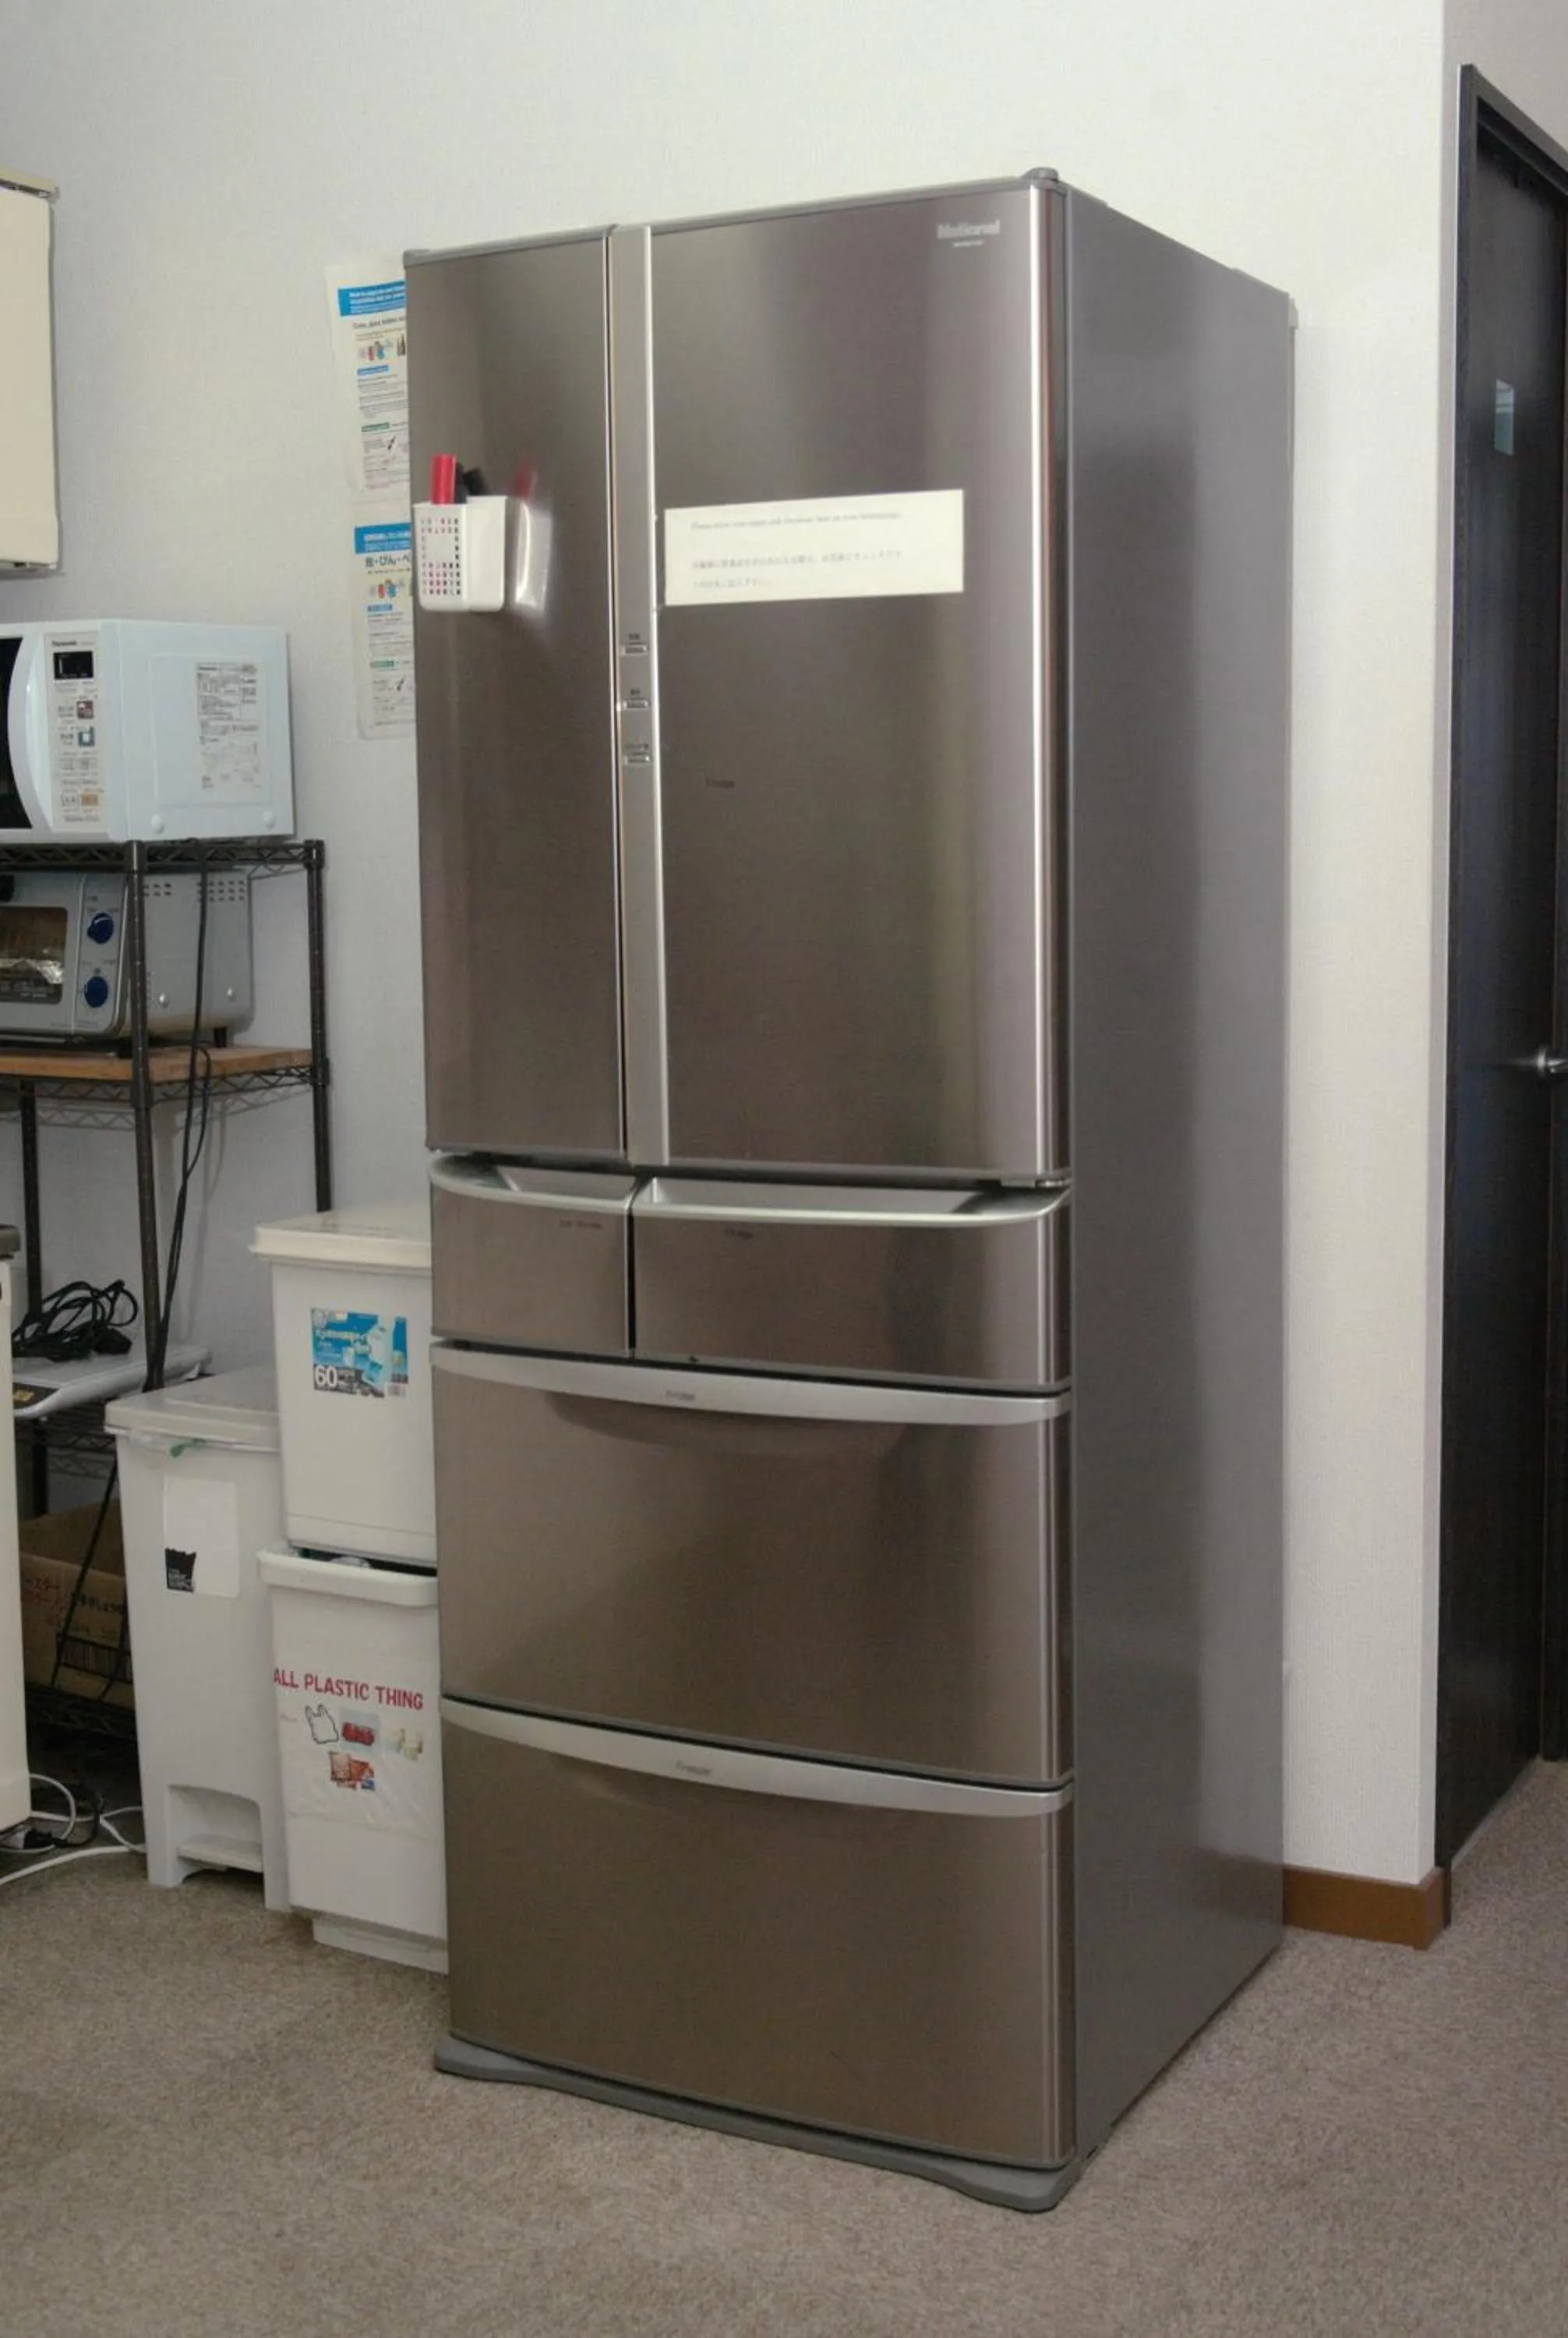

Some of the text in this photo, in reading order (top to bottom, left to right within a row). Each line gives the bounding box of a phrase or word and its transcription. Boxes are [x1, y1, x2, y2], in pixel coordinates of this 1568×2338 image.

[314, 1365, 337, 1387] 60
[274, 1668, 424, 1711] ALL PLASTIC THING
